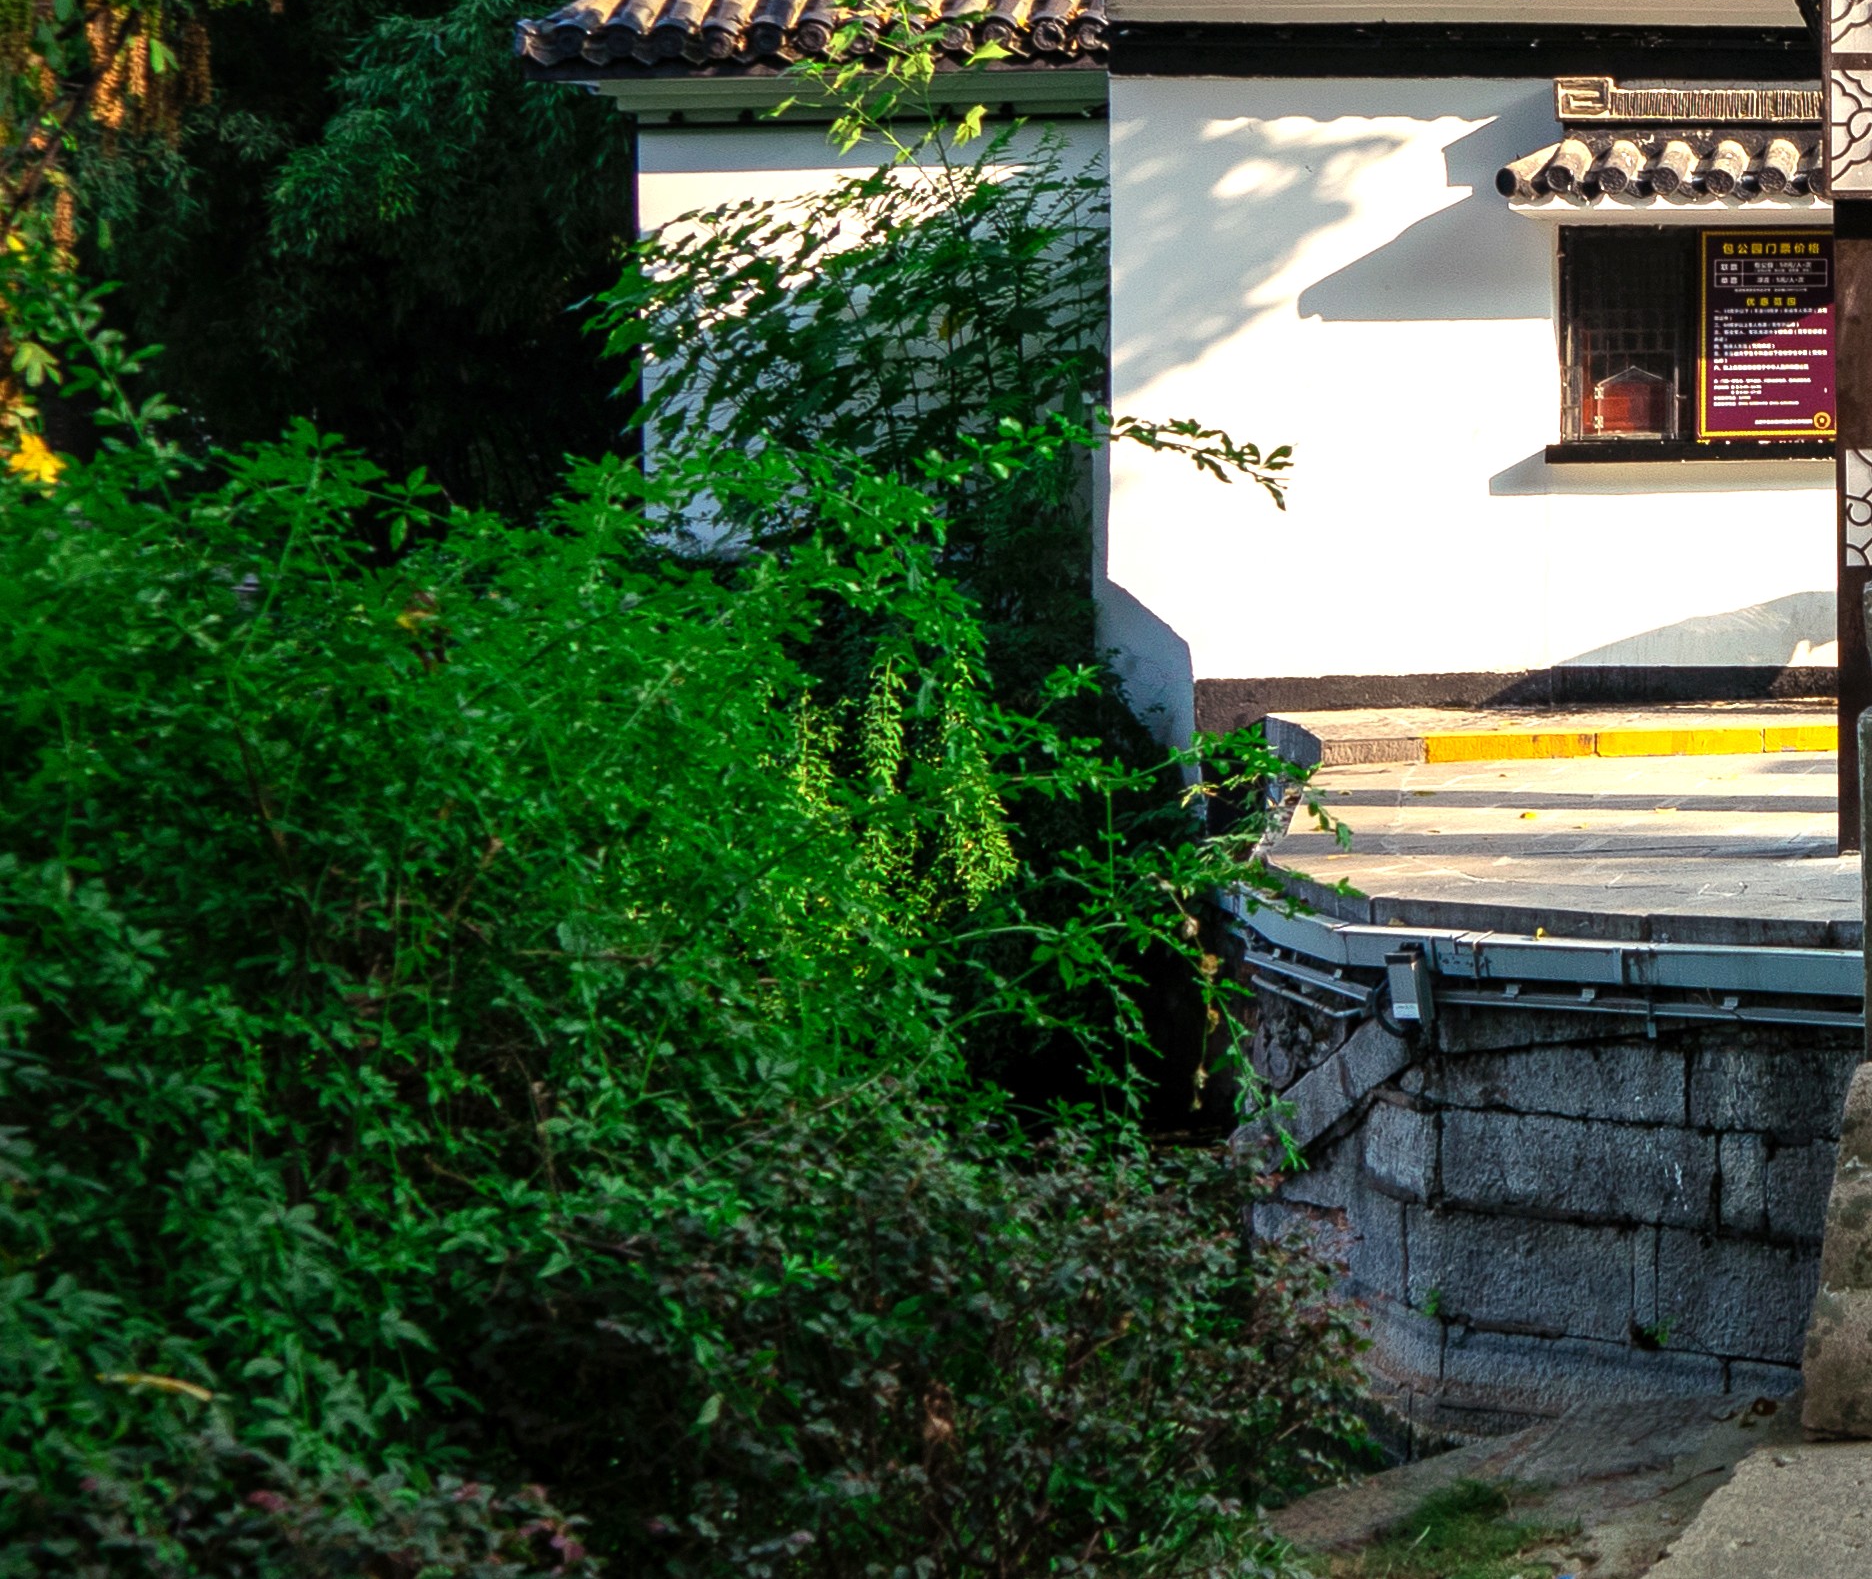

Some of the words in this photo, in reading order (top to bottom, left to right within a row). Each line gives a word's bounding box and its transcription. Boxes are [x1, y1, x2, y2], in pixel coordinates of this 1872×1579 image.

[1723, 243, 1819, 255] 包公园门票价格
